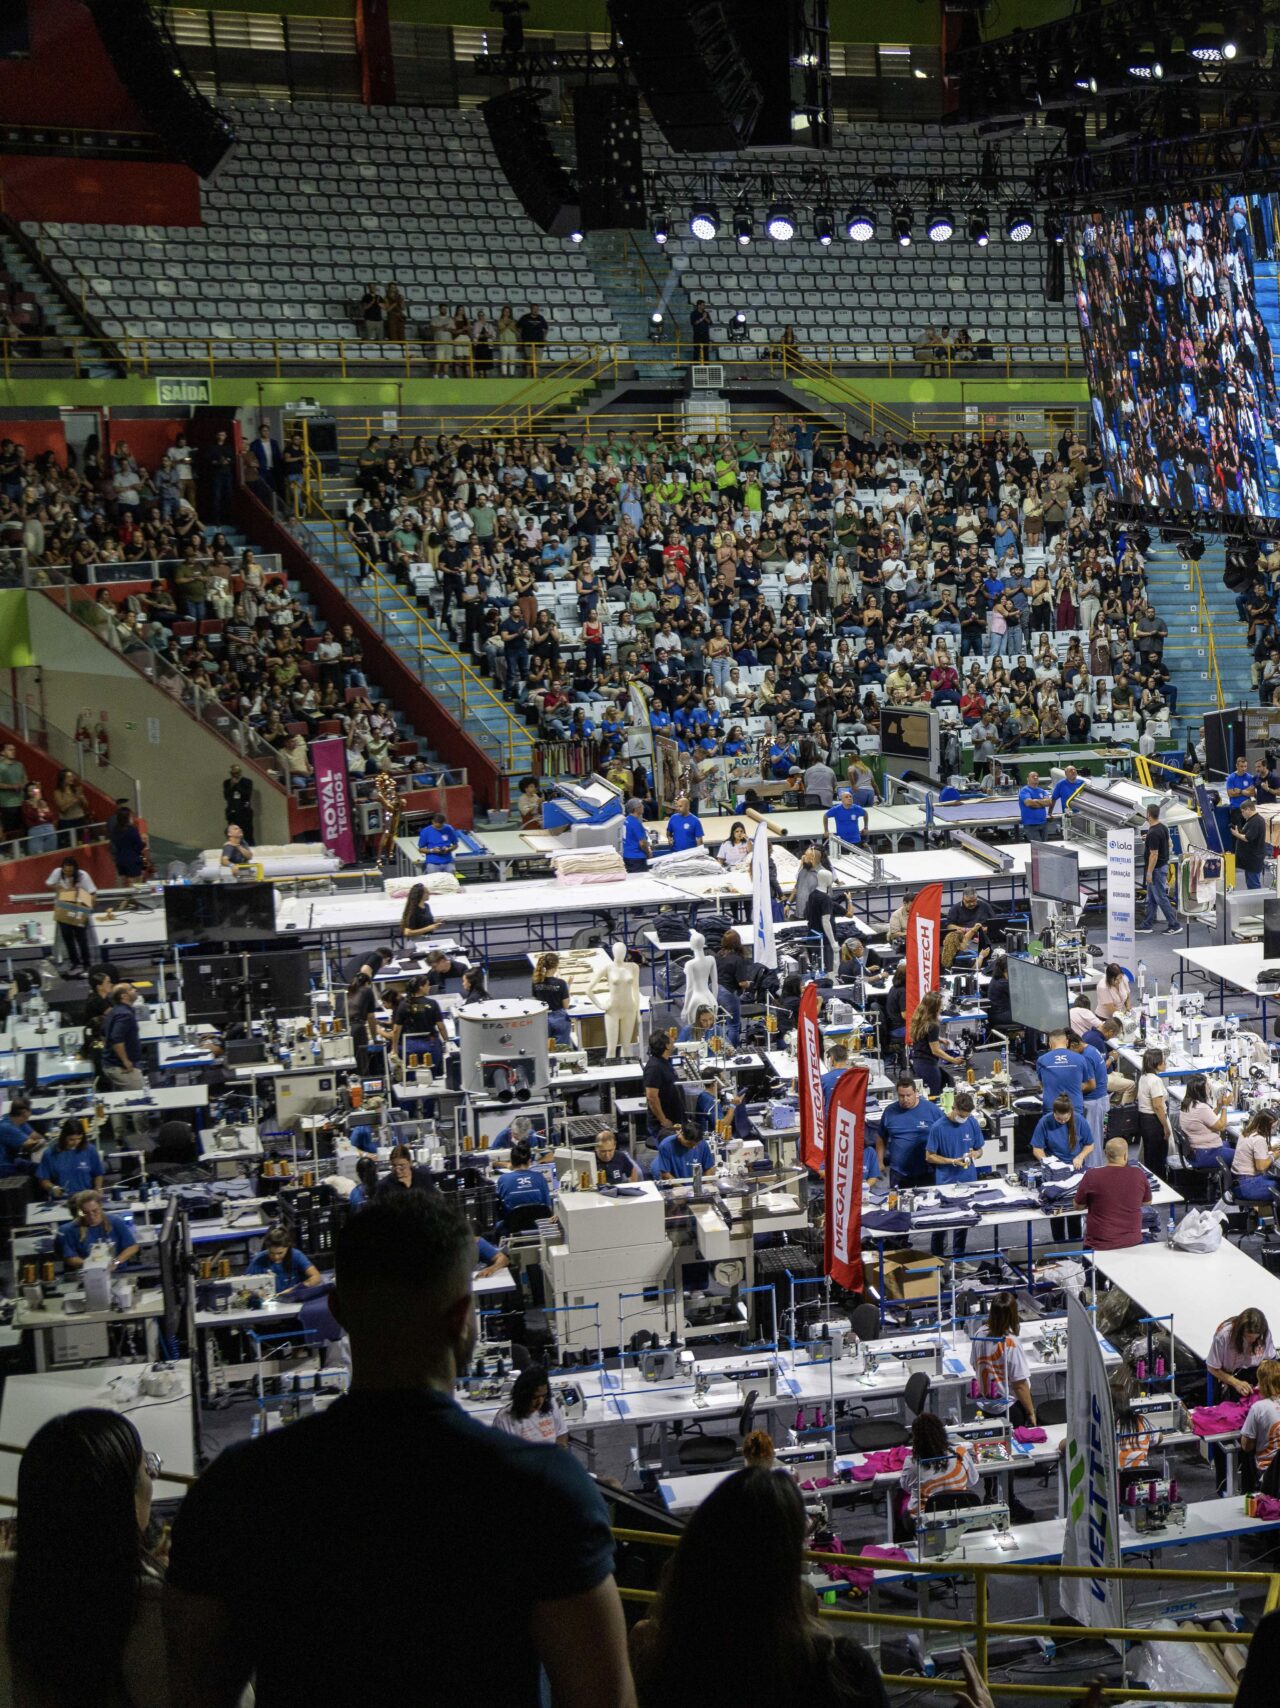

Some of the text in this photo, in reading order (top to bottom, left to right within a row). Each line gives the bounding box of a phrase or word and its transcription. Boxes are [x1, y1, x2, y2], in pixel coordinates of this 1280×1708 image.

[162, 382, 208, 401] SAÍDA
[320, 769, 338, 840] ROYAL
[334, 772, 348, 835] TECIDOS
[1117, 841, 1133, 851] lola
[920, 925, 932, 995] GATECH
[806, 1028, 825, 1142] MEGATECH
[835, 1118, 850, 1251] MEGATECH
